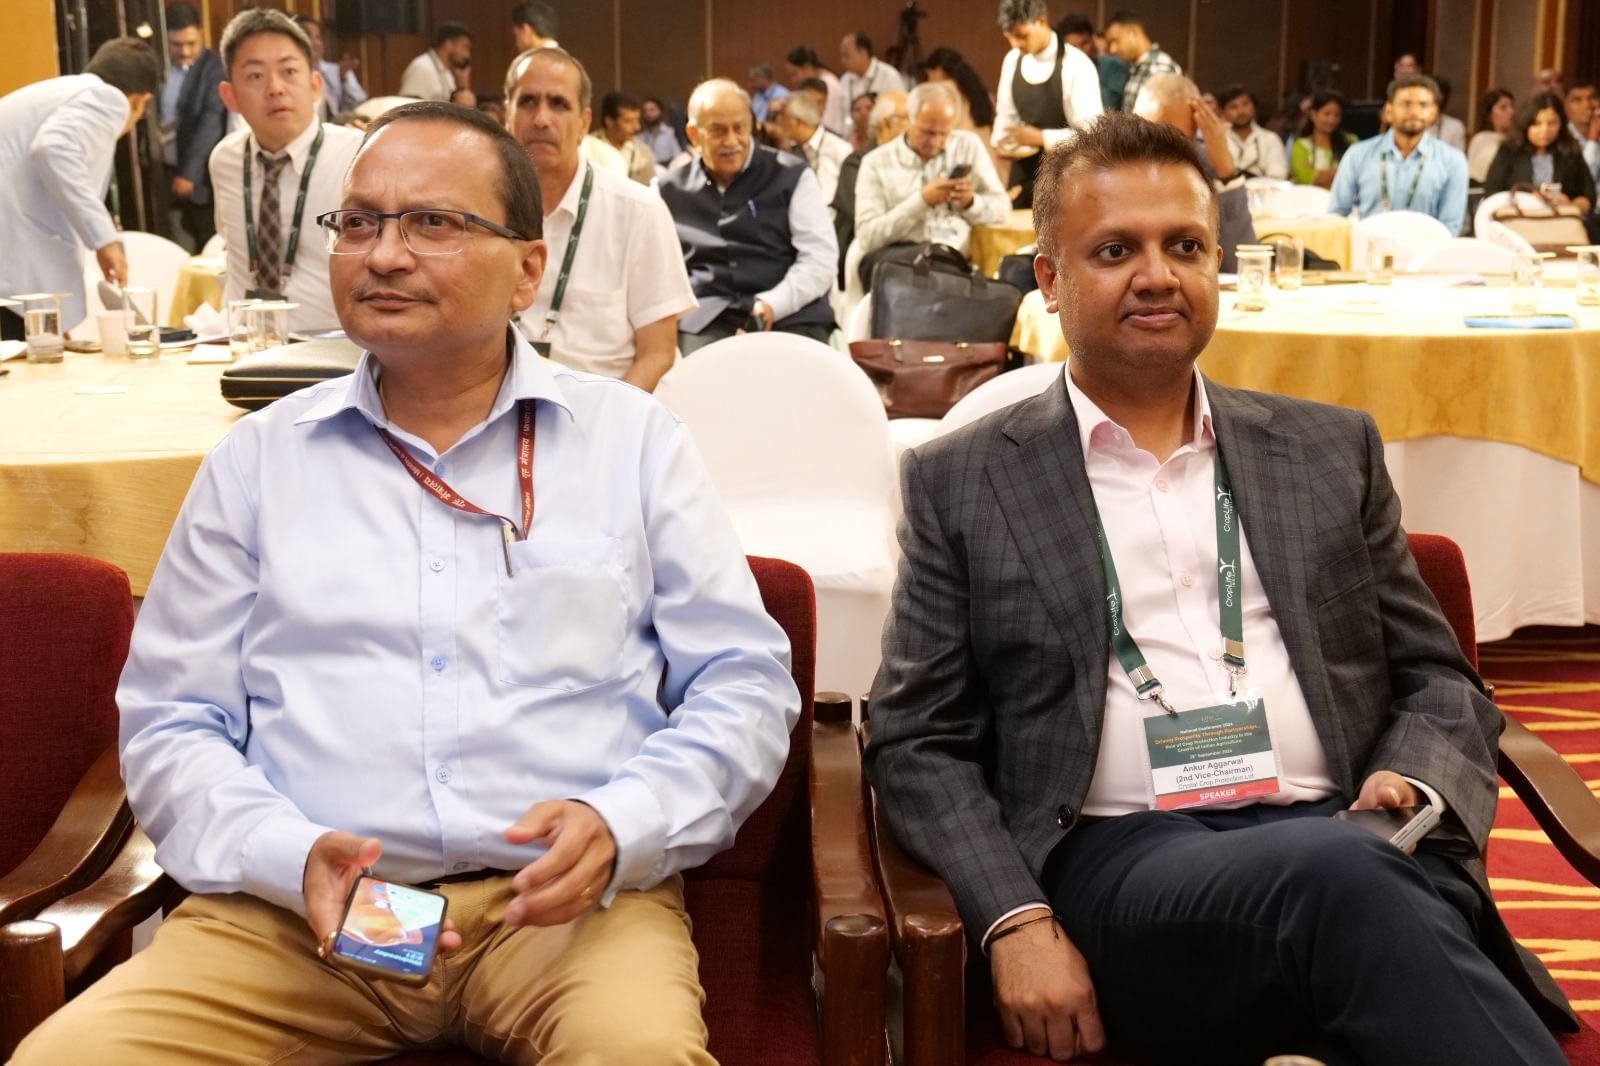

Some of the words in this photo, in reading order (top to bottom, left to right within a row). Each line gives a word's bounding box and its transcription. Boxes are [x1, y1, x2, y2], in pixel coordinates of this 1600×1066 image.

[520, 438, 530, 466] मंत्रालय
[423, 476, 452, 500] मंत्रालय
[1183, 764, 1206, 772] Ankur
[1208, 758, 1244, 770] Aggarwal
[1176, 775, 1193, 784] (2nd
[1194, 764, 1254, 780] Vice-Chairman)
[1178, 782, 1198, 790] Crystal
[1214, 775, 1244, 784] Protection
[1200, 788, 1237, 800] SPEAKER
